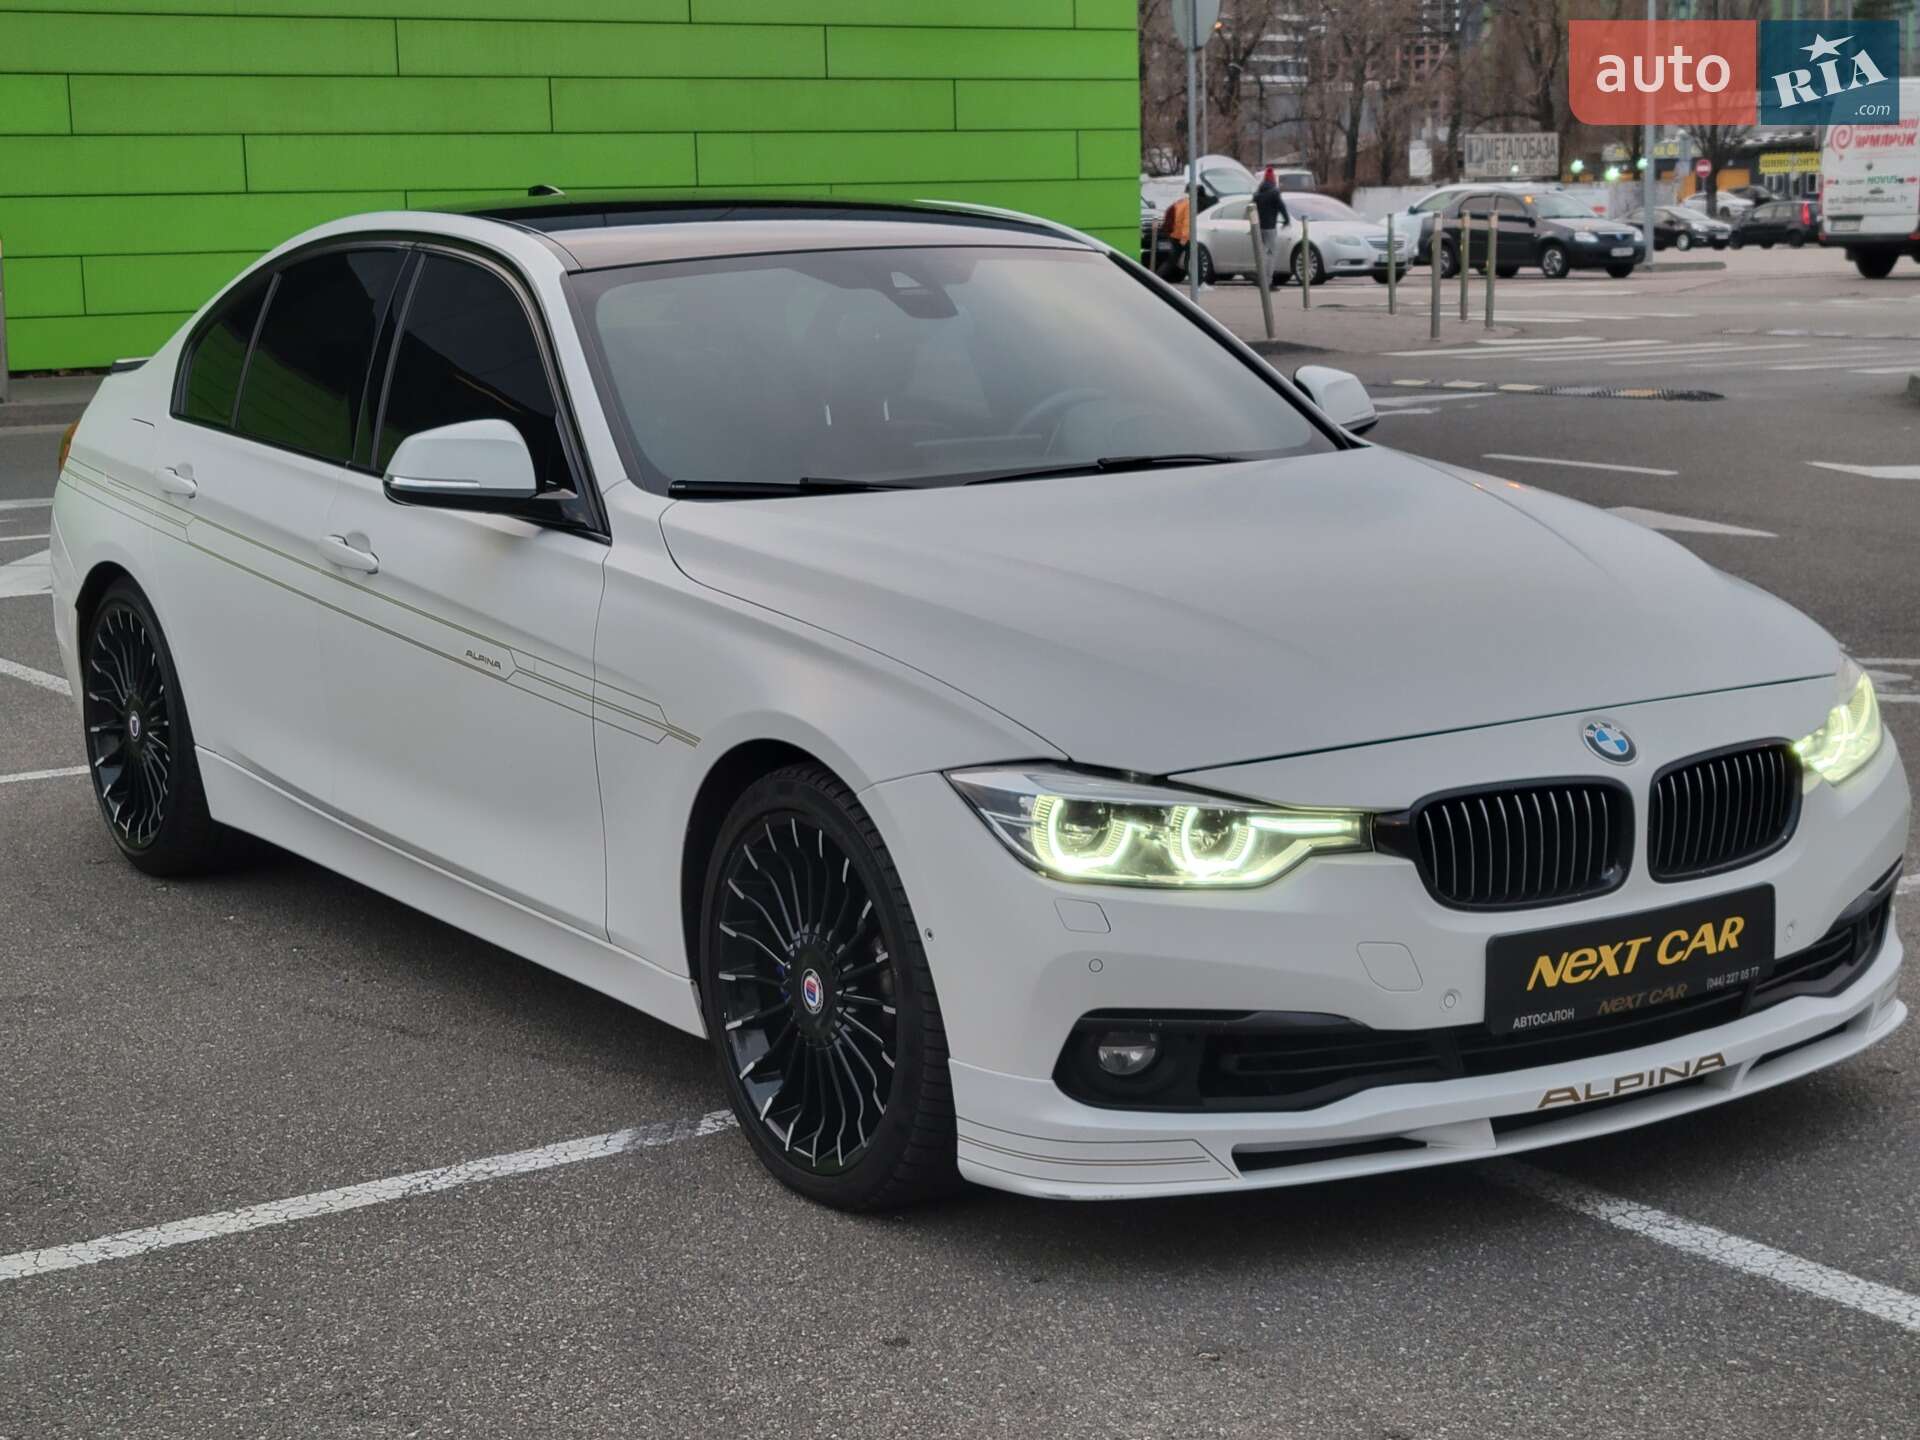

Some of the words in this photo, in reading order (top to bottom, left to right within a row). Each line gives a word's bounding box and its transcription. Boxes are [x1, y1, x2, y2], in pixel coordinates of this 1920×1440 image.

[1487, 136, 1557, 161] МЕТАЛОБАЗА
[465, 649, 502, 670] ALPINA
[1656, 915, 1746, 966] CAR
[1648, 982, 1688, 1005] CAR
[1512, 1006, 1575, 1030] АВТОСАЛОН
[1538, 1051, 1727, 1109] ALPINA
